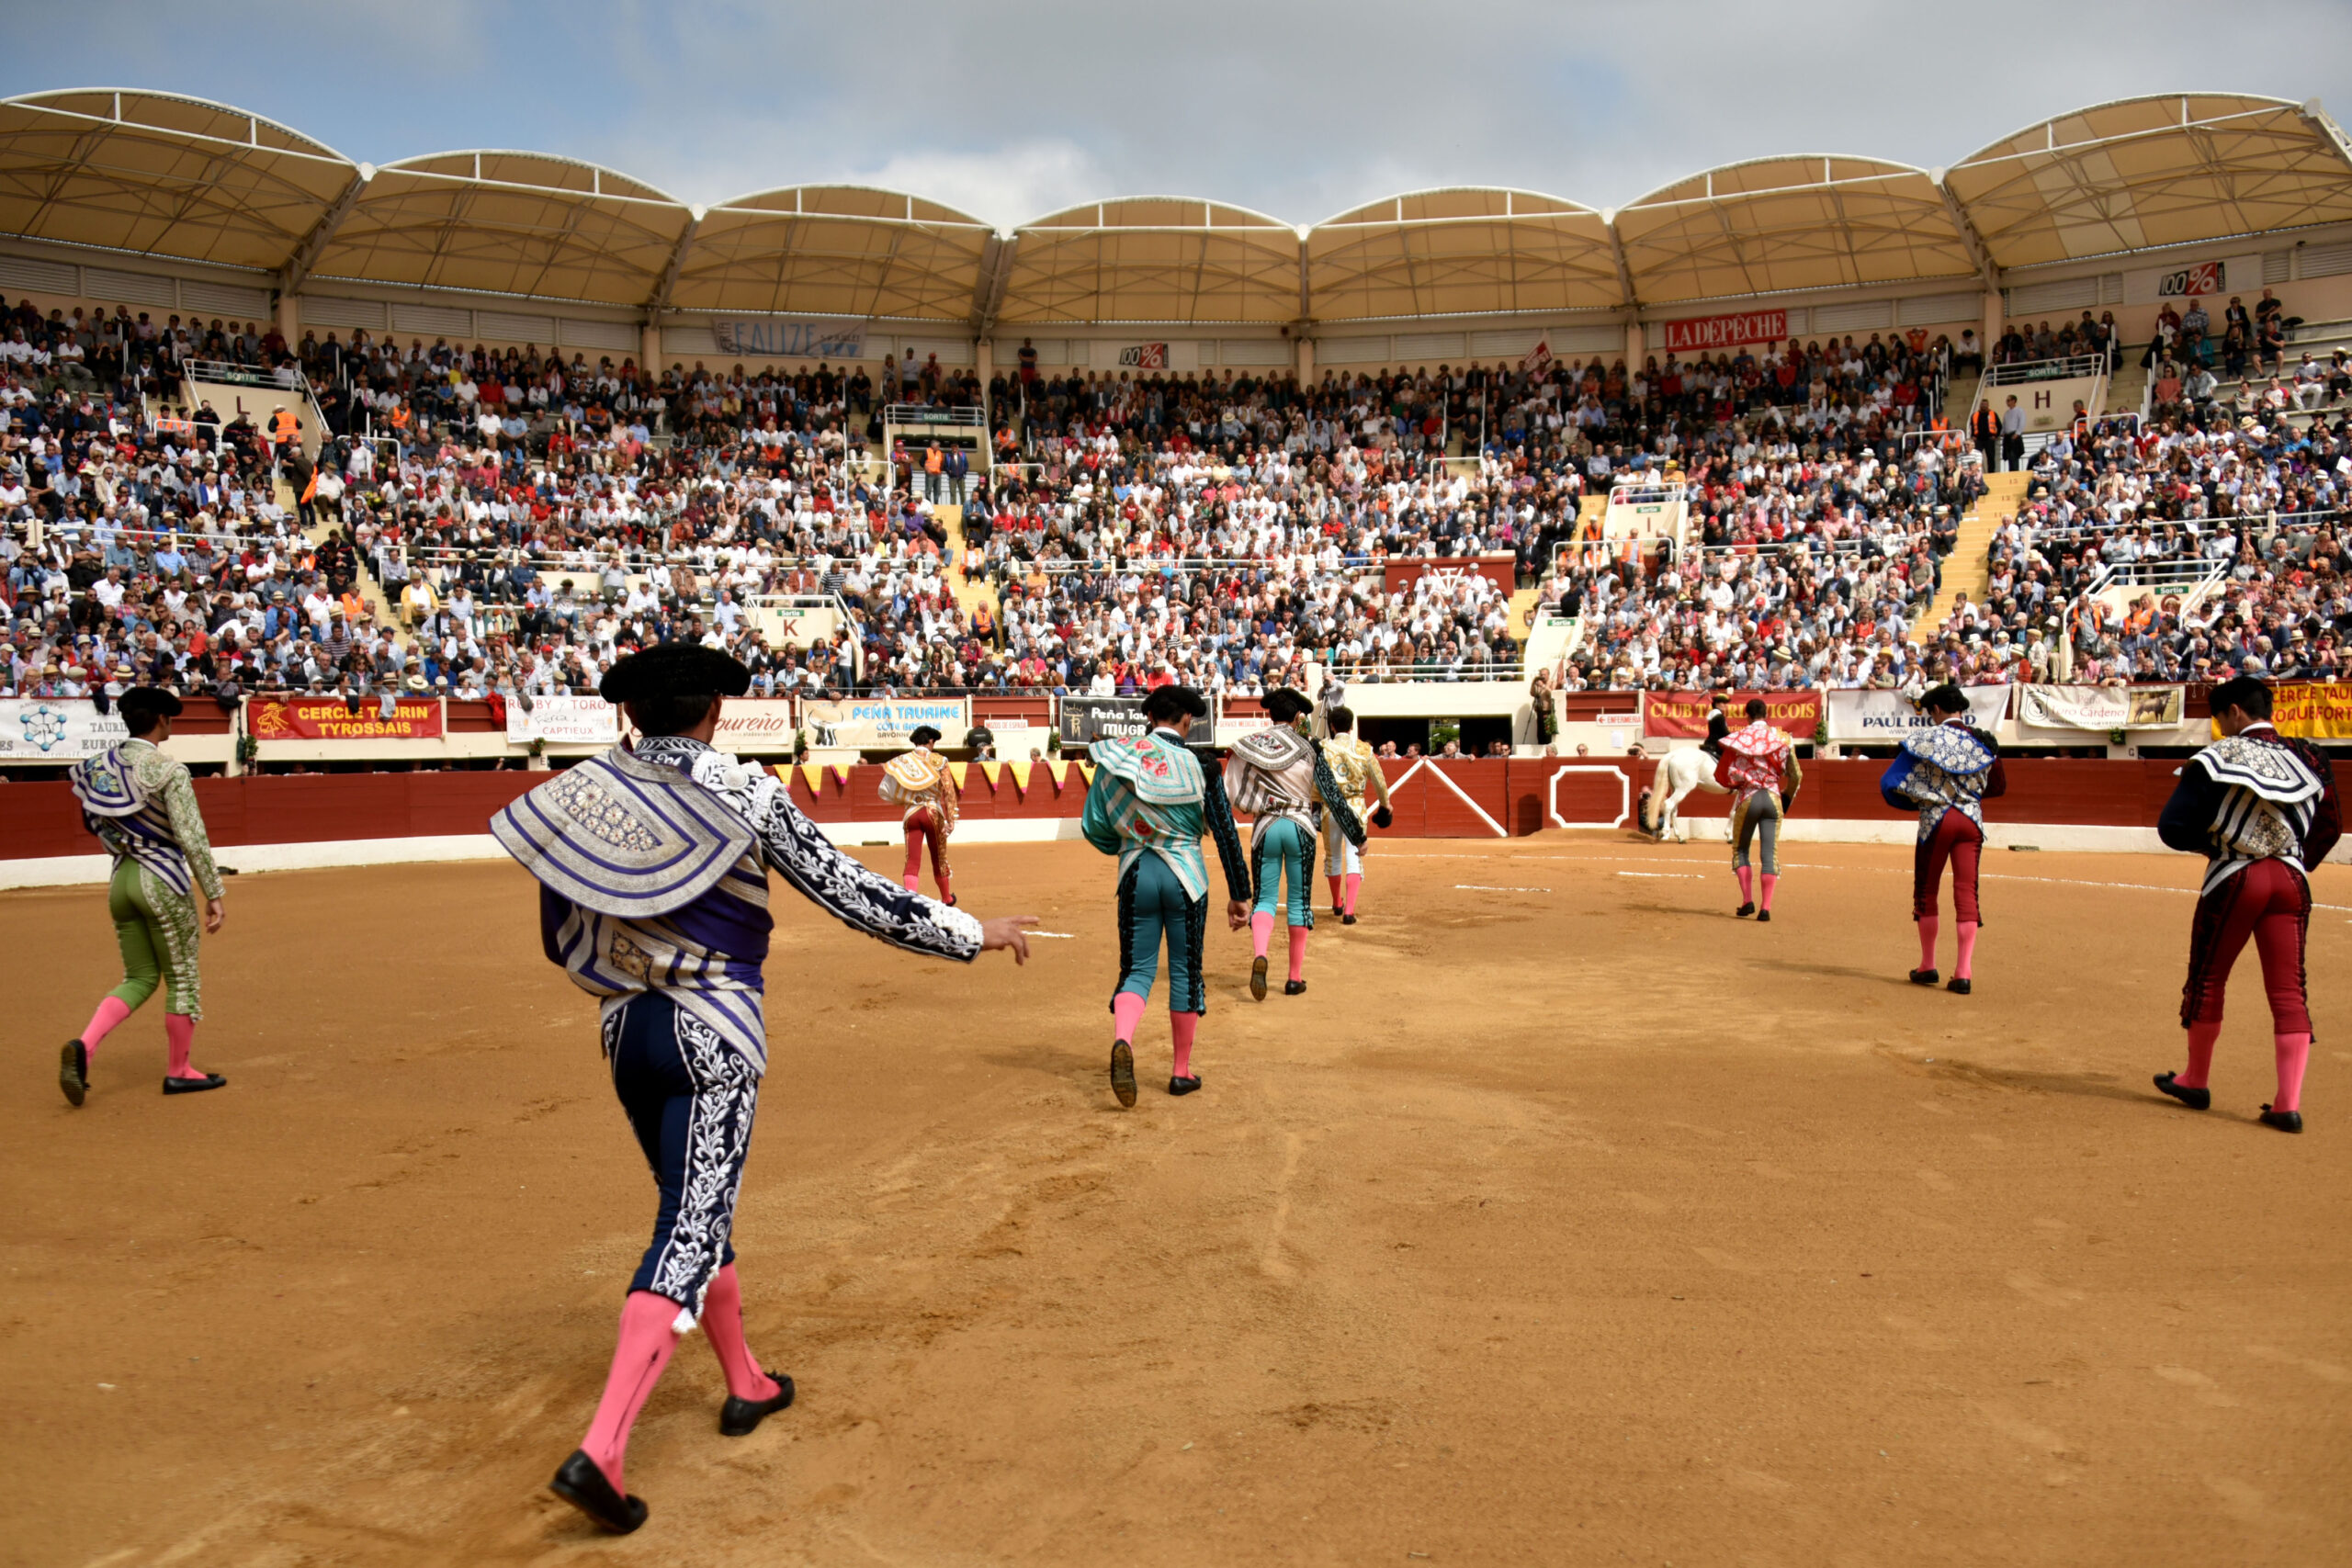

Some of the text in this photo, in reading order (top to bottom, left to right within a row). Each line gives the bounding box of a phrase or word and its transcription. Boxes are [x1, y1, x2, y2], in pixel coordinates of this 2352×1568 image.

[2161, 265, 2214, 294] 100%
[1668, 312, 1785, 347] LA DÉPÊCHE
[1121, 345, 1161, 367] 100%
[227, 371, 257, 382] SORTIE
[2029, 367, 2058, 377] SORTIE
[236, 396, 251, 415] L
[2035, 390, 2051, 410] H
[923, 412, 949, 421] SORTIE
[784, 619, 798, 636] K
[2323, 687, 2352, 700] TAU
[508, 698, 551, 709] RUBY
[571, 699, 614, 710] TOROS
[298, 706, 364, 720] CERCLE
[368, 705, 428, 719] TURIN
[853, 703, 960, 719] PEÑA TAURINE
[1091, 706, 1148, 719] Peña Tau
[1650, 703, 1692, 718] CLUB
[1607, 716, 1641, 724] ENFERMERIA
[1862, 715, 1976, 728] PAUL RICD
[317, 722, 412, 736] TYROSSAIS
[542, 727, 594, 735] CAPTIEUX
[1102, 723, 1147, 736] MUGR
[1832, 746, 1838, 754] F
[2128, 748, 2134, 757] G
[540, 756, 547, 765] E
